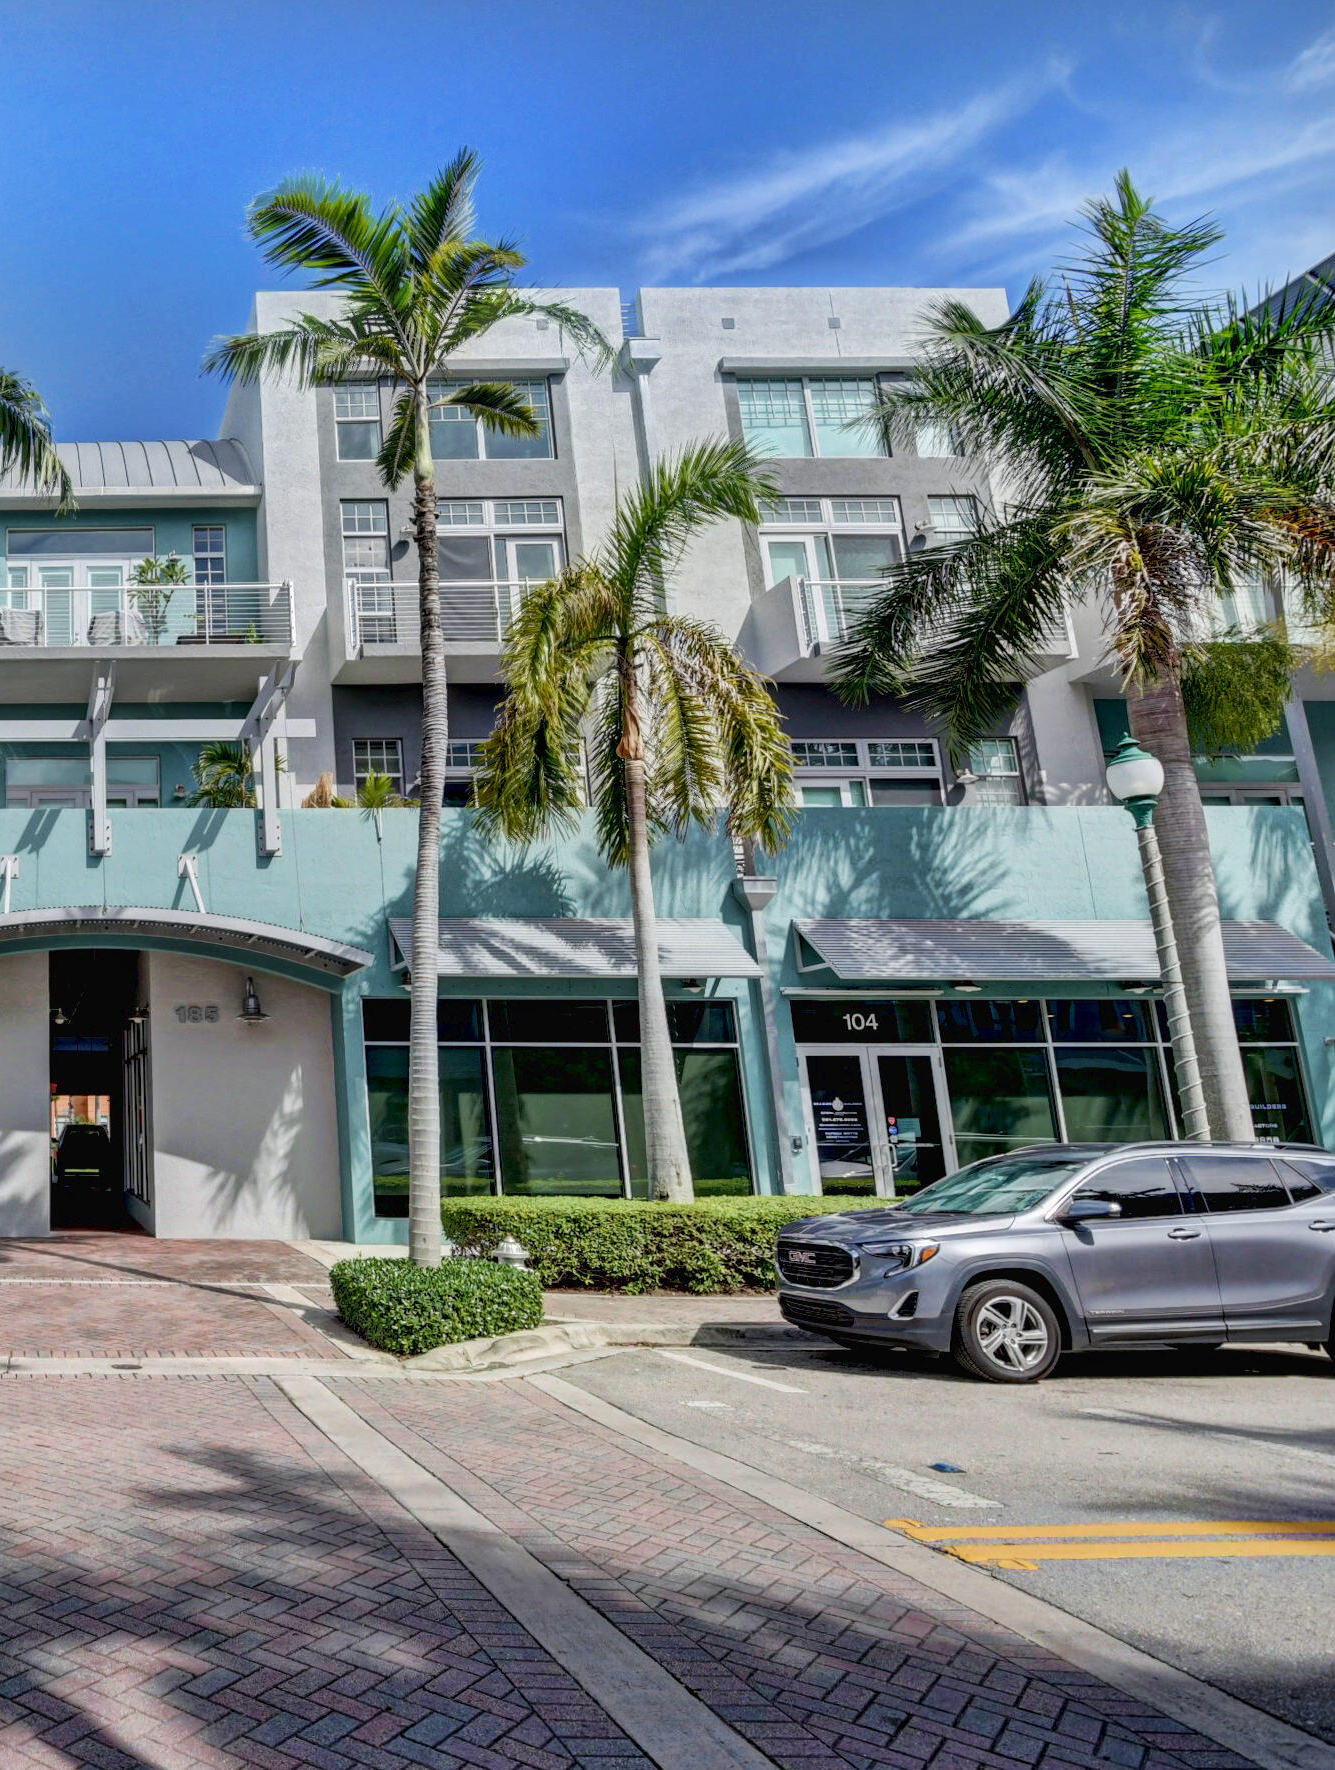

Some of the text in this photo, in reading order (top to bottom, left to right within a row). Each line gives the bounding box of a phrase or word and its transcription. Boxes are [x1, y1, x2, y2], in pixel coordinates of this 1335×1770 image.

[175, 1006, 219, 1023] 185
[843, 1013, 879, 1030] 104
[789, 1251, 816, 1264] GMC
